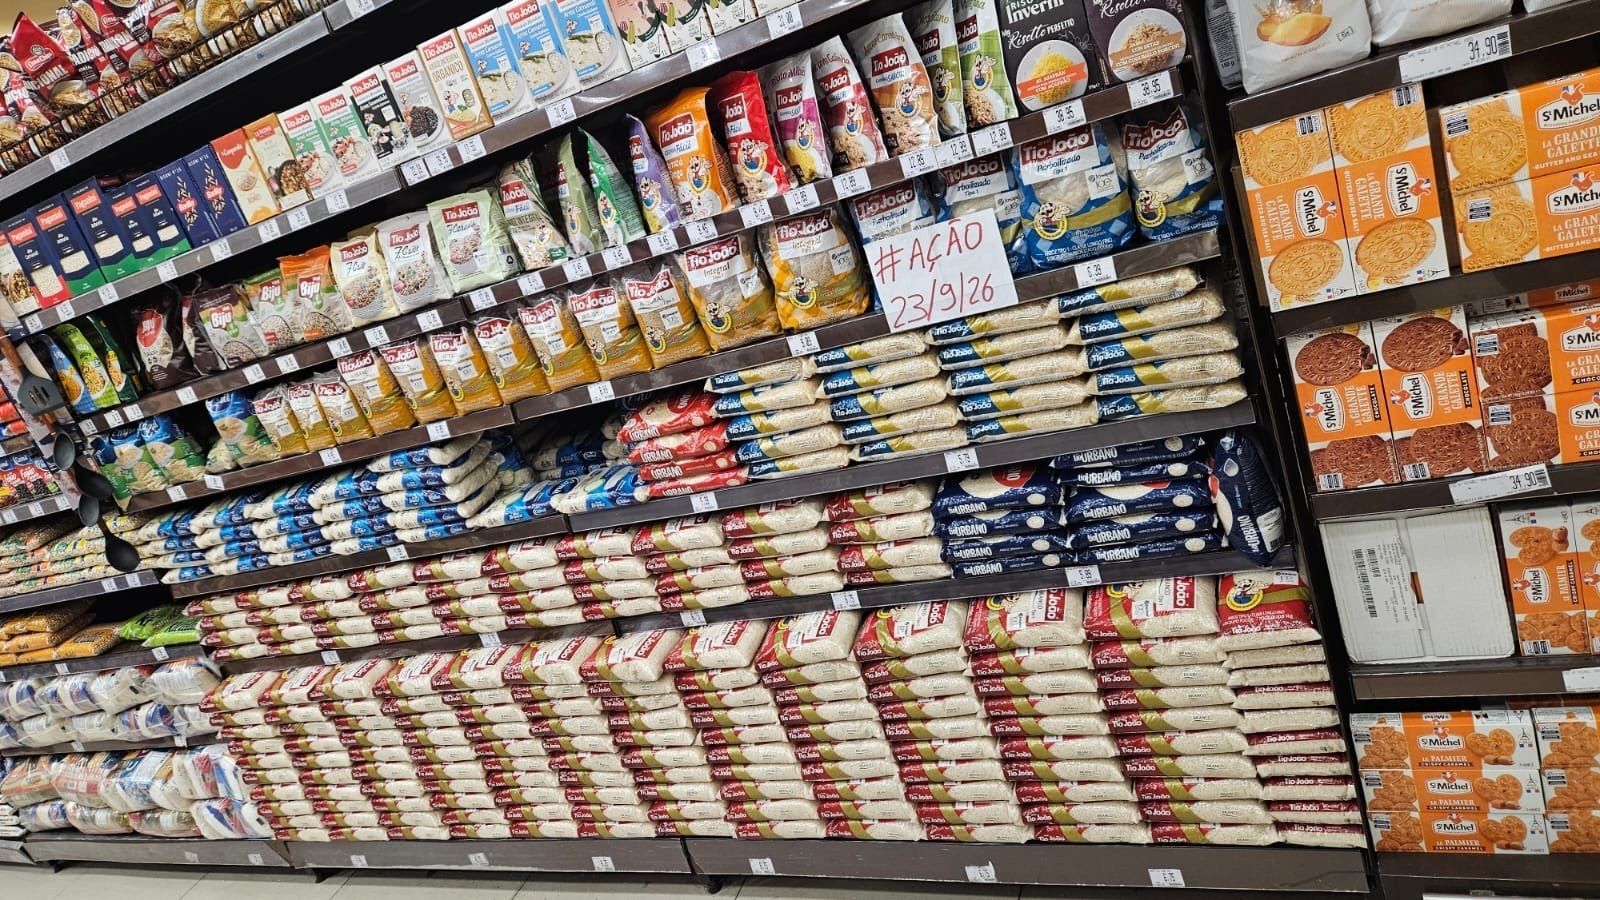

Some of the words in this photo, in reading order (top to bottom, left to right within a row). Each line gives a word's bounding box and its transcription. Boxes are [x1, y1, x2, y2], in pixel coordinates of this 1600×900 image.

[1008, 23, 1050, 50] Risotto
[671, 120, 692, 139] João
[1128, 131, 1149, 151] Tio
[1149, 113, 1183, 143] João
[1023, 144, 1047, 165] Tio
[1050, 131, 1089, 155] João
[1355, 177, 1372, 220] GALETTE
[1368, 180, 1385, 220] GRANDE
[1395, 177, 1413, 212] Michel
[457, 205, 479, 219] João
[799, 216, 829, 235] João
[1266, 200, 1283, 241] GALETTE
[1279, 203, 1295, 240] GRANDE
[1303, 200, 1320, 233] Michel
[687, 253, 707, 269] Tio
[707, 245, 737, 265] João
[586, 292, 615, 309] João
[890, 272, 994, 328] 23/9/26
[1319, 390, 1336, 420] Michel
[1356, 384, 1373, 423] GALETTE
[1407, 376, 1424, 408] Michel
[1446, 371, 1463, 410] GALETTE
[641, 449, 674, 463] URBANO
[1528, 569, 1542, 592] Michel
[1429, 736, 1461, 747] Michel
[1437, 780, 1470, 790] Michel
[1443, 821, 1475, 832] Michel
